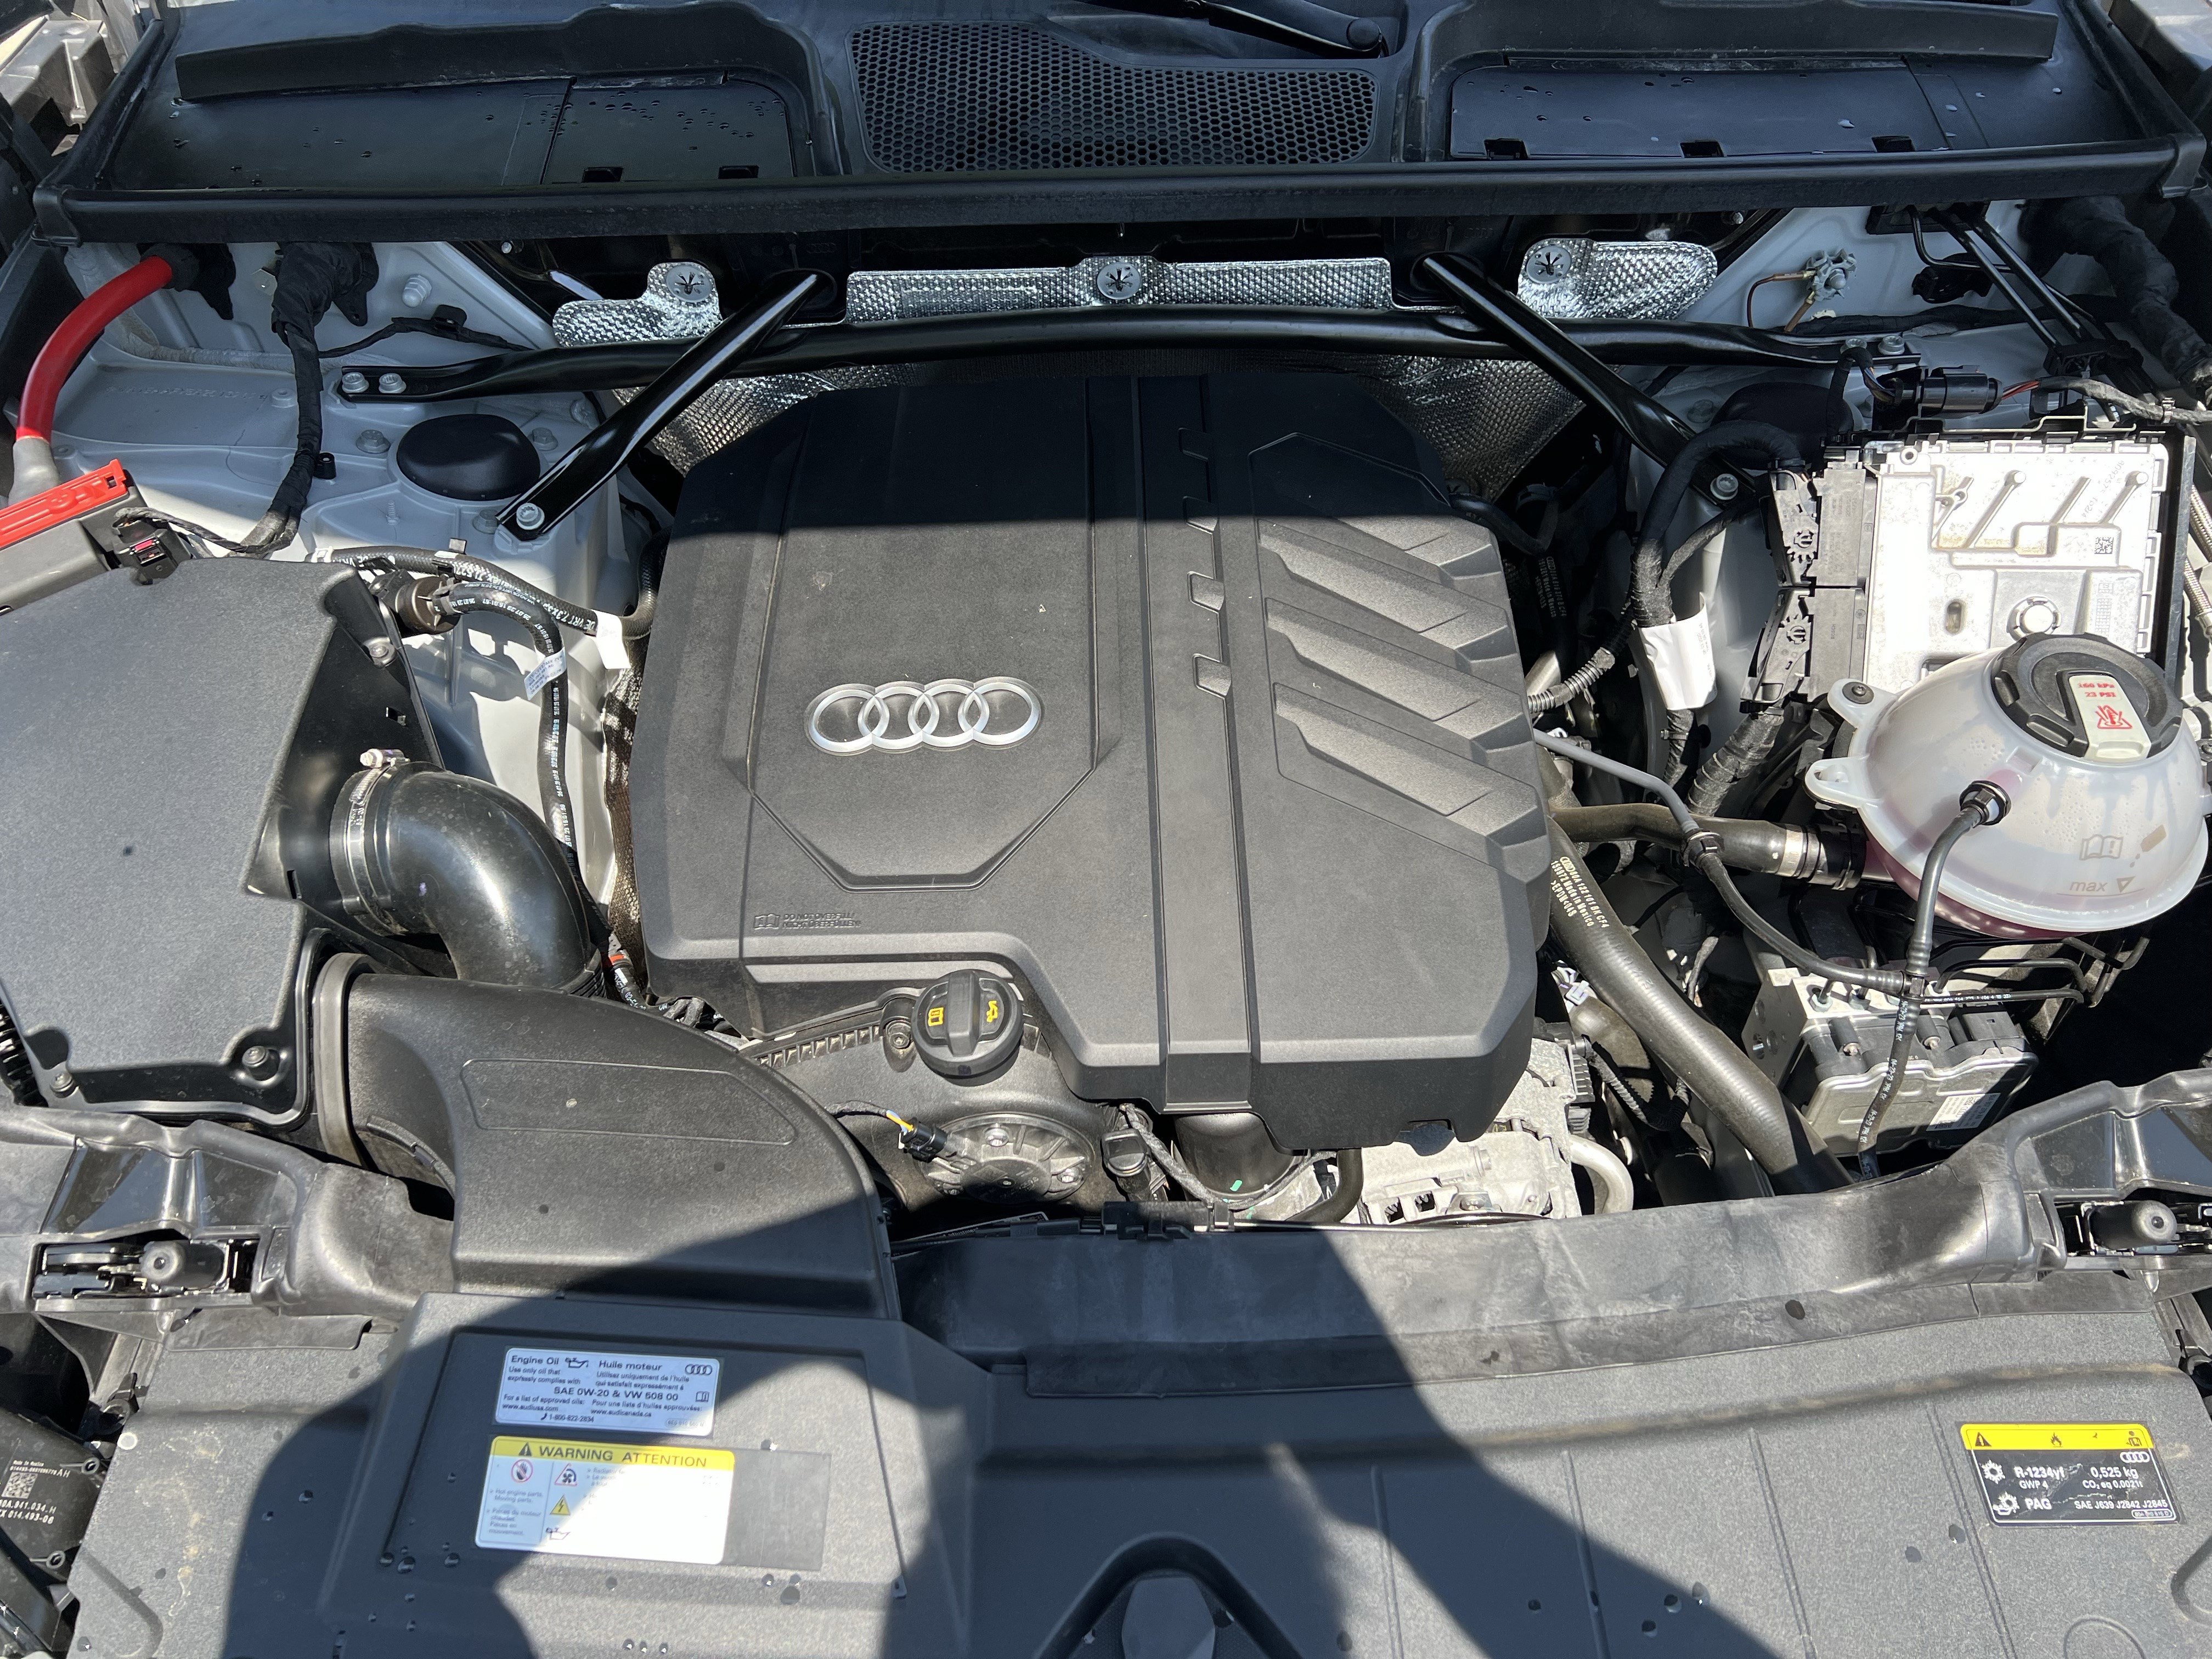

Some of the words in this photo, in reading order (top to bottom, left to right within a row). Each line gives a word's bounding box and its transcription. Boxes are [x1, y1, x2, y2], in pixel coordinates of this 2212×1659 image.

[568, 614, 586, 627] VRT
[586, 619, 596, 630] DE
[1562, 880, 1577, 897] Made
[2069, 881, 2108, 891] max
[1573, 895, 1582, 904] in
[1577, 883, 1589, 894] 122
[1583, 894, 1596, 905] 101
[1596, 915, 1610, 928] CF4
[1577, 902, 1594, 927] Mexico
[511, 1355, 543, 1364] Engine
[546, 1357, 559, 1365] Oil
[599, 1359, 623, 1369] Huile
[625, 1362, 663, 1370] moteur
[554, 1386, 575, 1395] SAE
[577, 1387, 610, 1397] 0W-20
[624, 1390, 643, 1398] VW
[666, 1393, 678, 1401] 00
[539, 1446, 613, 1462] WARNING
[622, 1452, 707, 1467] ATTENTION
[2014, 1466, 2065, 1480] R-1234yf
[2090, 1466, 2122, 1479] 0,525
[2123, 1466, 2138, 1480] kg
[2019, 1481, 2039, 1489] GWP
[2041, 1481, 2049, 1489] 4
[2024, 1498, 2052, 1510] PAG
[2074, 1500, 2094, 1509] SAE
[2095, 1500, 2114, 1510] J639
[2116, 1500, 2141, 1509] J2842
[2142, 1499, 2168, 1508] J2845
